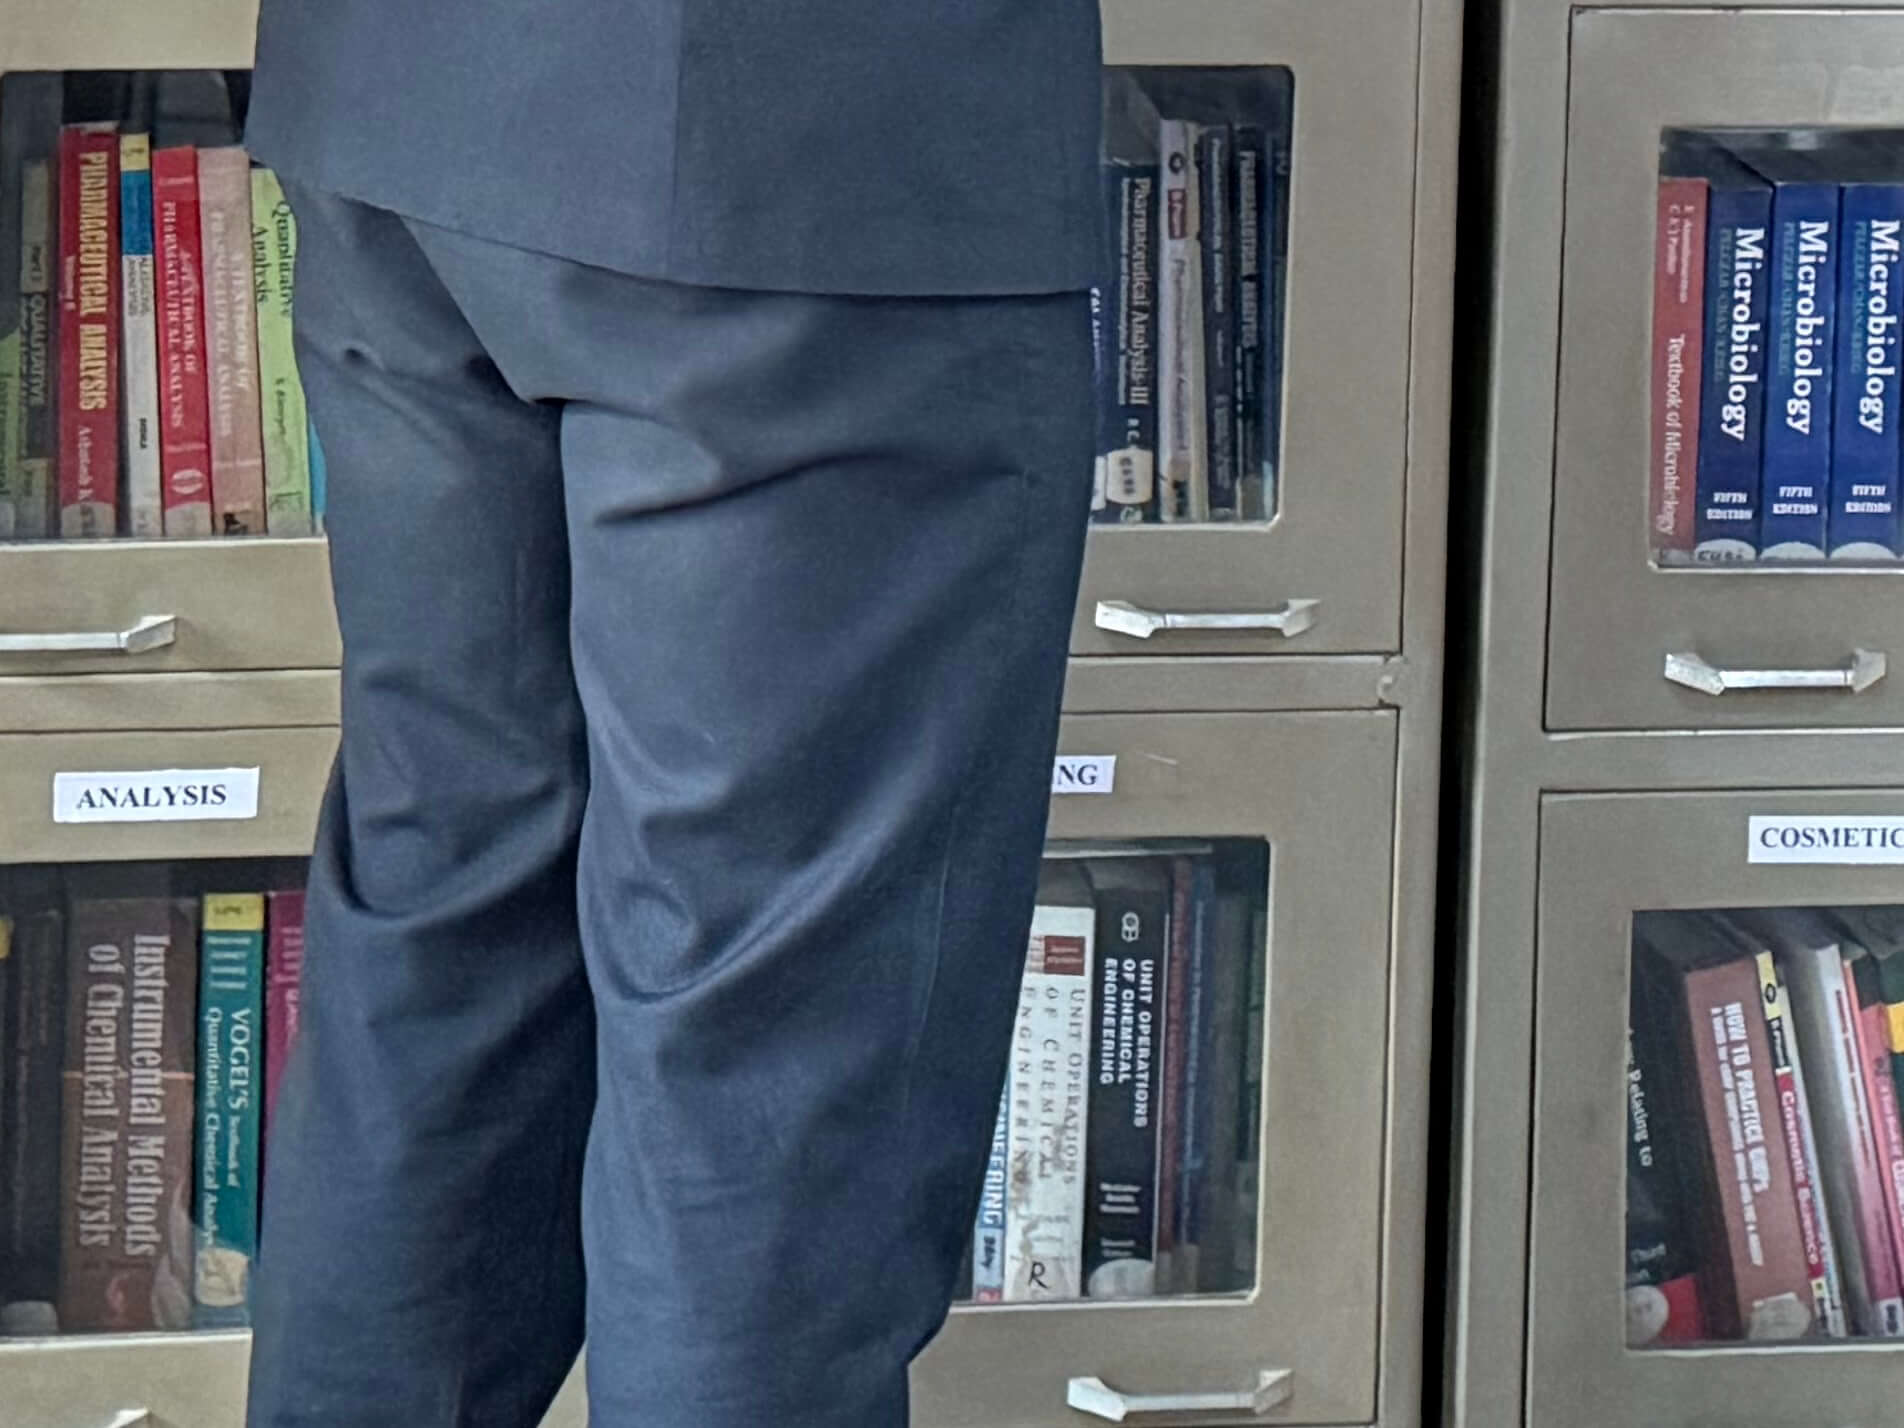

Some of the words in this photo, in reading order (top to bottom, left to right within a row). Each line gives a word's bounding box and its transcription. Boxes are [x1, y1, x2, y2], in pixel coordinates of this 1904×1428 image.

[79, 151, 108, 316] PHARMACEUTICAL
[79, 324, 107, 411] ANALYSIS
[1668, 333, 1687, 410] Textbook
[1721, 227, 1765, 441] Microbiology
[1786, 220, 1829, 435] Microbiology
[1859, 220, 1901, 435] Microbiology
[1668, 411, 1682, 429] of
[76, 784, 228, 810] ANALYSIS
[89, 944, 121, 975] of
[1122, 957, 1137, 984] OF
[1140, 958, 1154, 1005] UNIT
[81, 981, 120, 1117] Chemical
[128, 933, 172, 1126] Instrumental
[204, 1007, 225, 1107] Quantitative
[229, 1007, 253, 1111] VOGEL'S
[1069, 988, 1086, 1043] UNIT
[1100, 957, 1119, 1085] ENGINEERING
[1117, 988, 1136, 1084] CHEMICAL
[1724, 1002, 1744, 1041] HOW
[1732, 1045, 1751, 1069] TO
[1132, 1010, 1153, 1128] OPERATIONS
[77, 1125, 118, 1248] Analysis
[124, 1131, 166, 1257] Methods
[202, 1111, 222, 1190] Chemical
